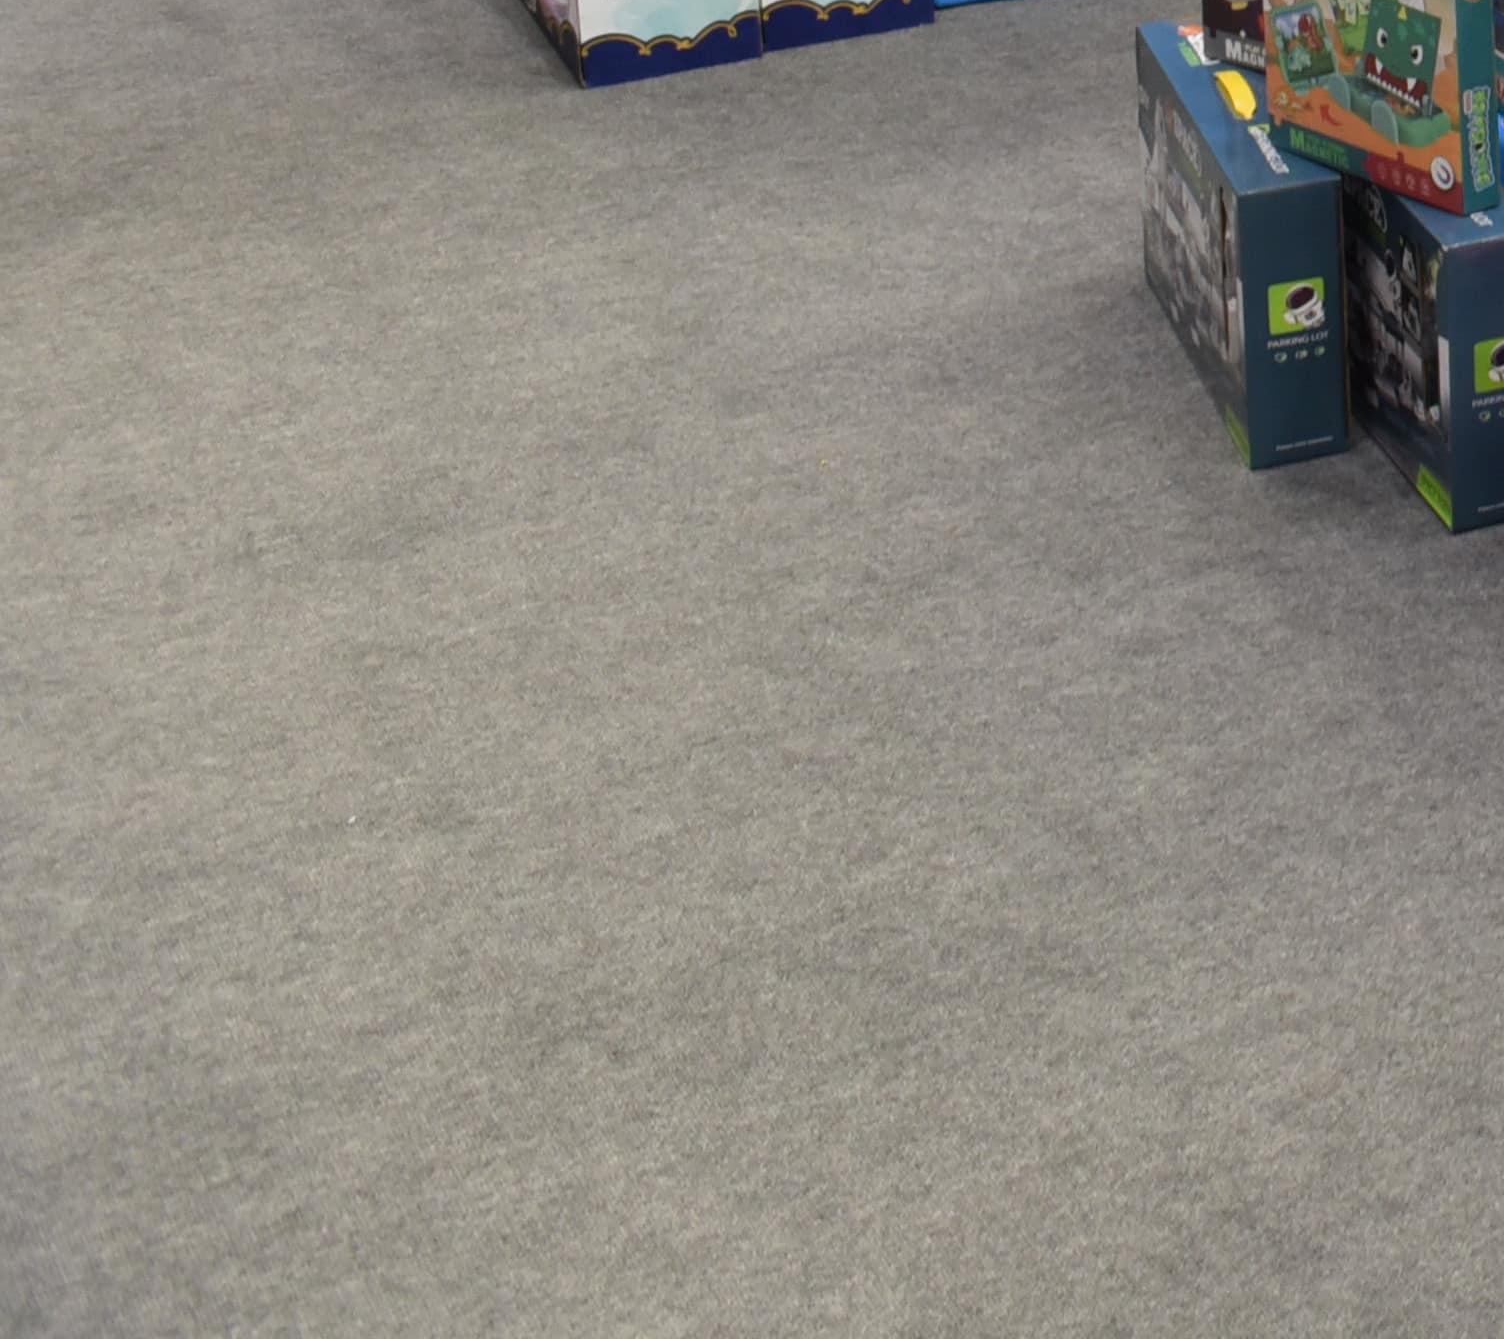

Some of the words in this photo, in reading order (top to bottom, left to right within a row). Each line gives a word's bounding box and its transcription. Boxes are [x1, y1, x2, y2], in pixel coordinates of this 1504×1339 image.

[1225, 36, 1266, 69] MAGN
[1267, 334, 1308, 351] PARKING
[1310, 329, 1330, 344] LOT
